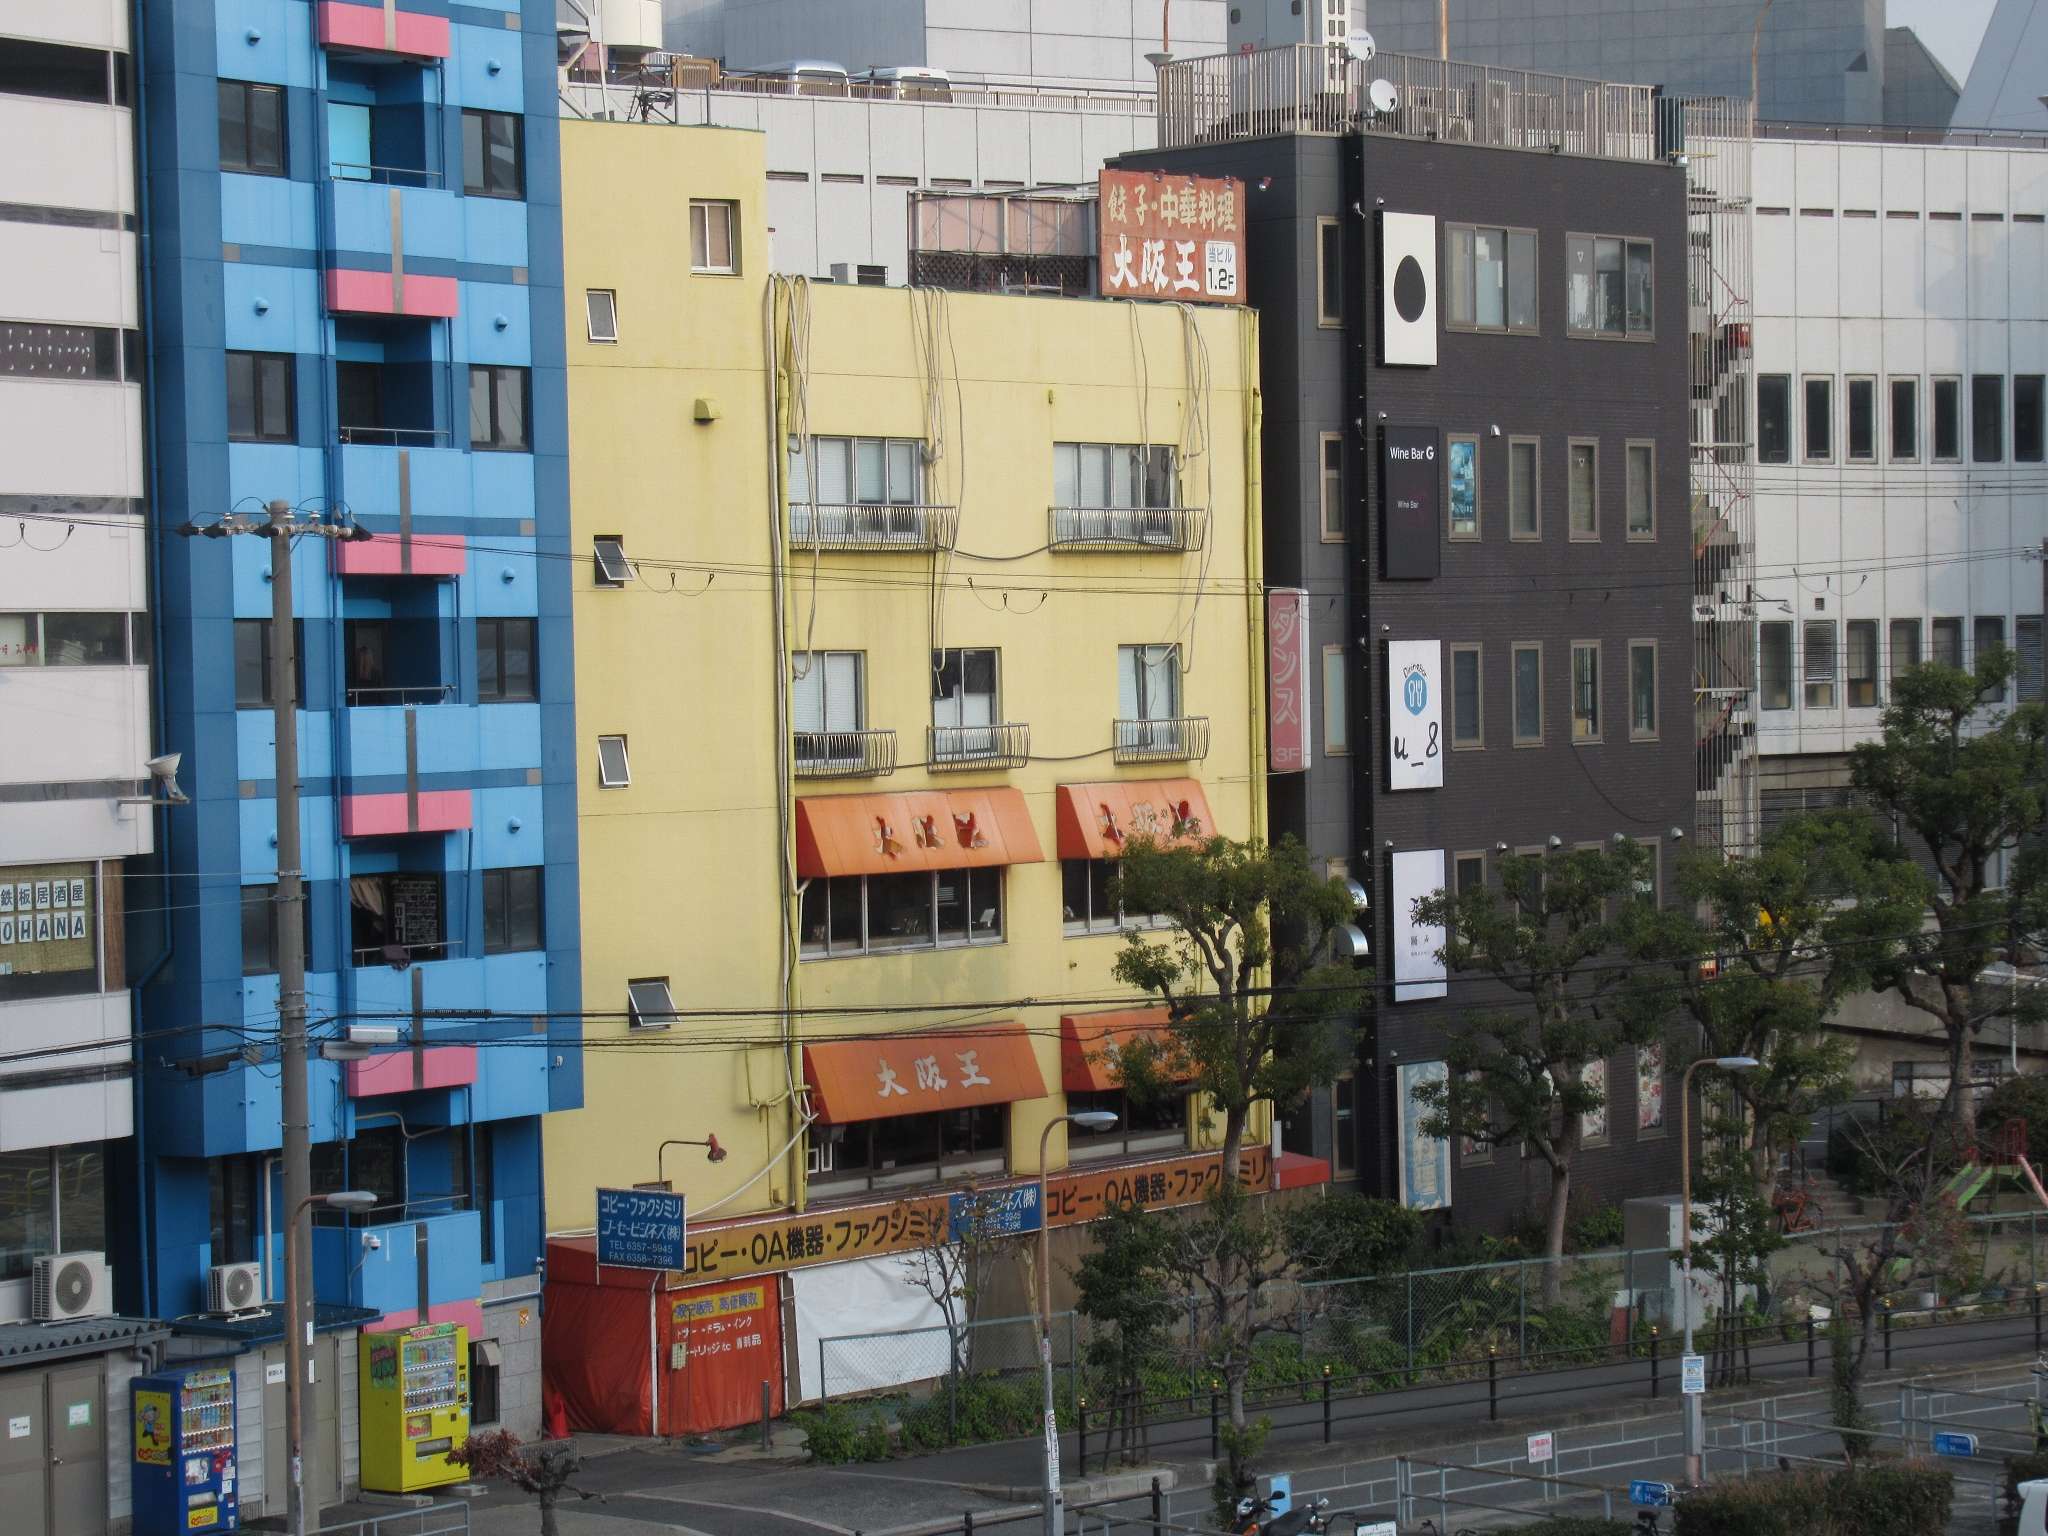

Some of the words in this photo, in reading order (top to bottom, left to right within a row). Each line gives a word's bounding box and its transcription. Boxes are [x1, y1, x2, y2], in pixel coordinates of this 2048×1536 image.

[1109, 233, 1201, 294] 大阪王
[1389, 446, 1410, 460] Wine
[1411, 447, 1425, 460] Bar
[1426, 445, 1435, 460] G
[1271, 603, 1299, 725] ダンス
[1275, 747, 1302, 763] 3F
[0, 884, 84, 906] 鉄板居酒屋
[3, 915, 84, 941] OHANA
[876, 1050, 991, 1098] 大阪王
[609, 1240, 625, 1250] TEL
[609, 1251, 625, 1261] FAX
